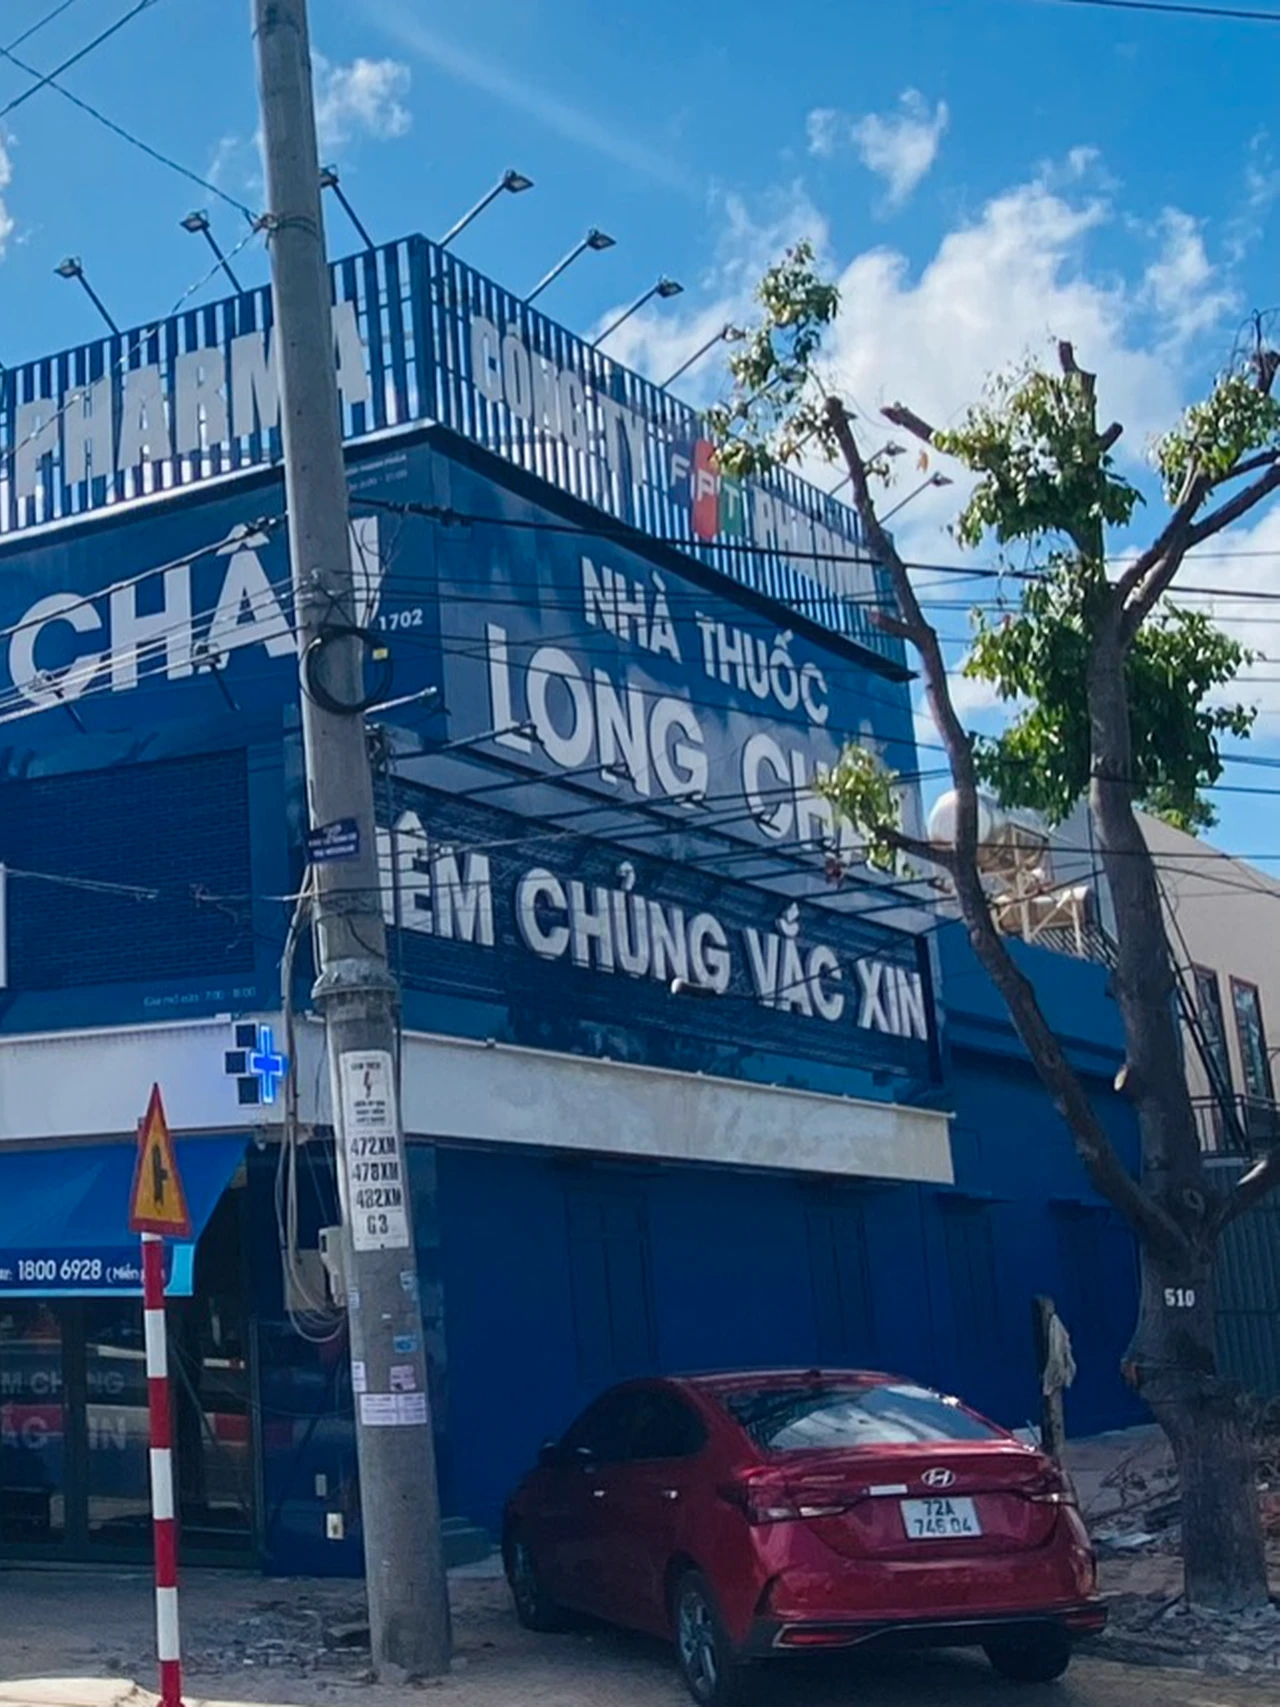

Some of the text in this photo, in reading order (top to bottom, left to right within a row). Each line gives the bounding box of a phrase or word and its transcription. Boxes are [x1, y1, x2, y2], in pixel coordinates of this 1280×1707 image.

[471, 315, 588, 453] CÔNG
[594, 390, 646, 486] TY
[671, 451, 742, 519] FPT
[379, 608, 424, 632] 1702
[581, 555, 830, 725] NHÀ THUỐC
[486, 622, 908, 877] LONG CH
[374, 810, 929, 1042] IÊM CHỦNG VẮC XIN
[350, 1135, 397, 1156] 472XM
[18, 1260, 56, 1281] 1800
[59, 1259, 102, 1281] 6928
[1164, 1287, 1195, 1307] 510
[923, 1500, 956, 1517] 72A
